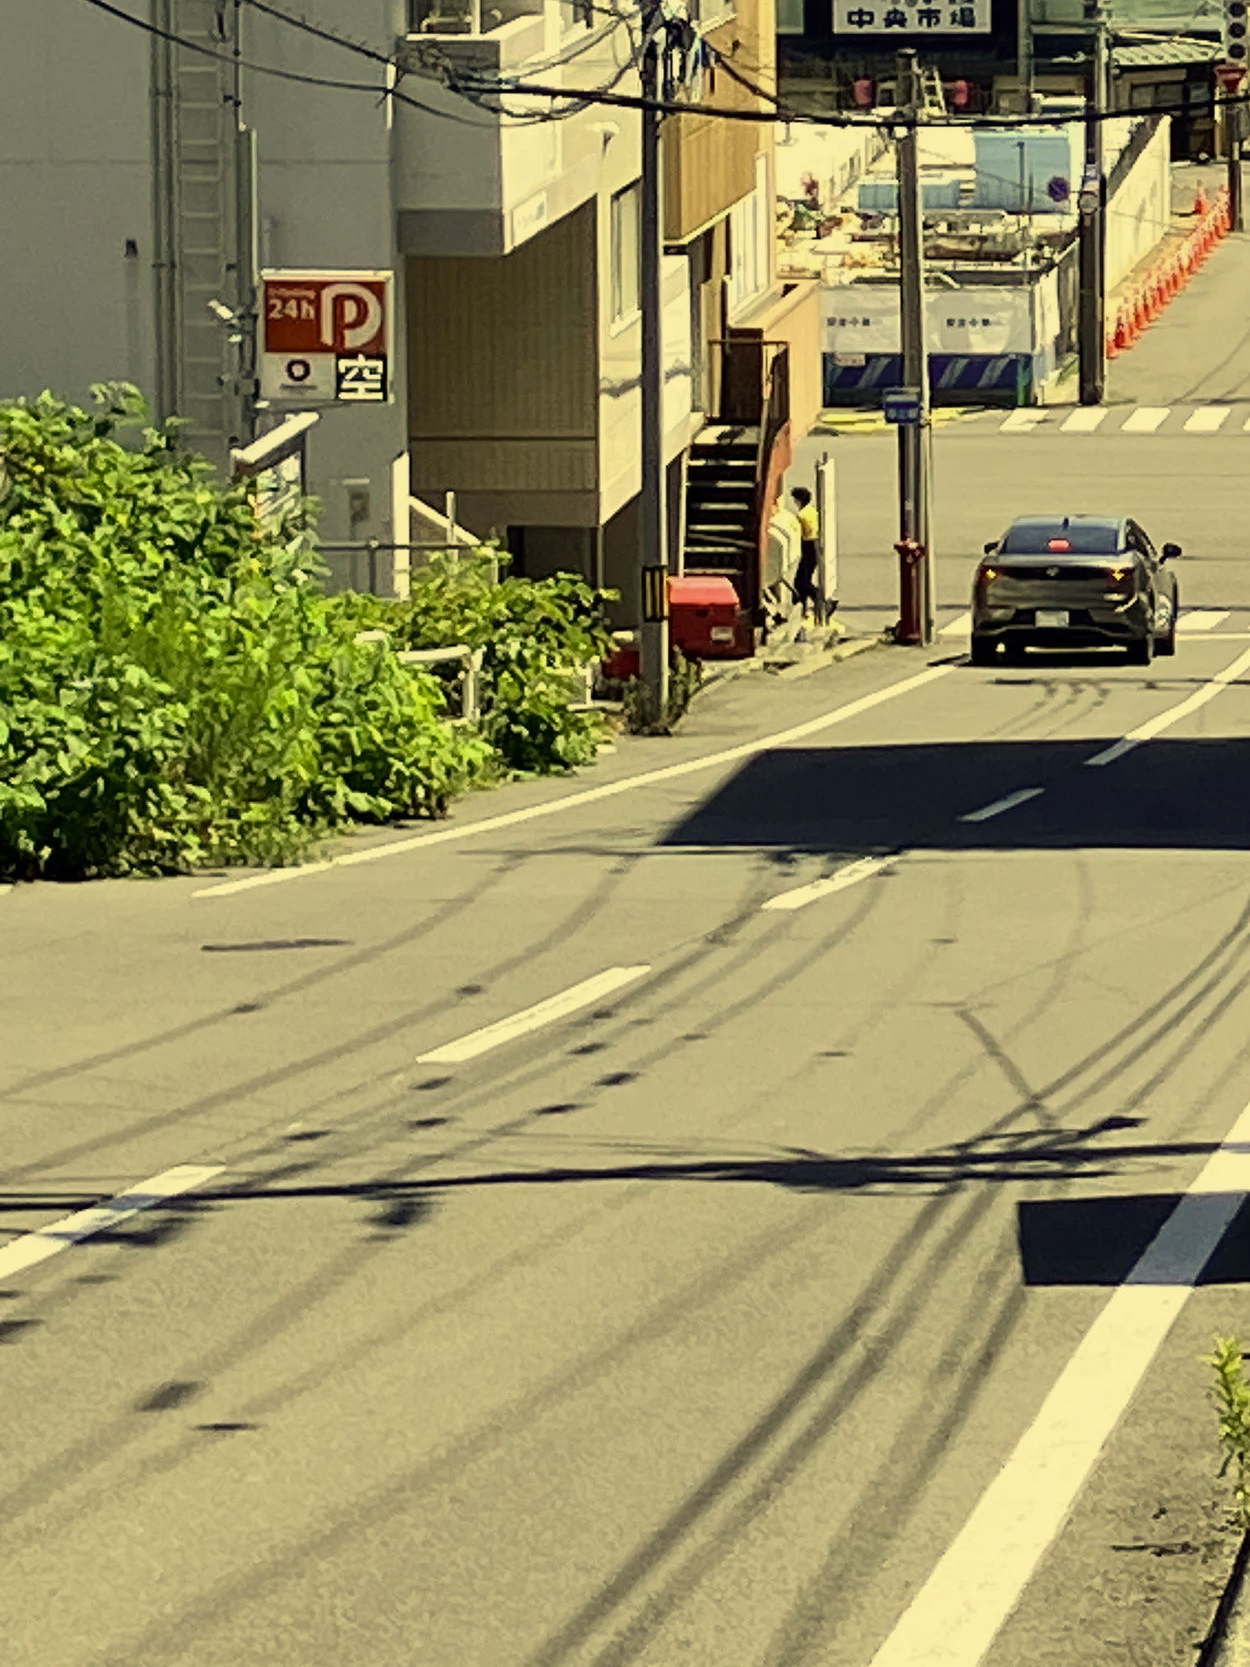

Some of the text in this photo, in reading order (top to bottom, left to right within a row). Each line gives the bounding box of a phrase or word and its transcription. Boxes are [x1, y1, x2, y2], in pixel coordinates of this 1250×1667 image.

[847, 7, 976, 29] 中央市場
[268, 299, 315, 320] 24h
[320, 283, 382, 350] P
[338, 354, 384, 400] 空
